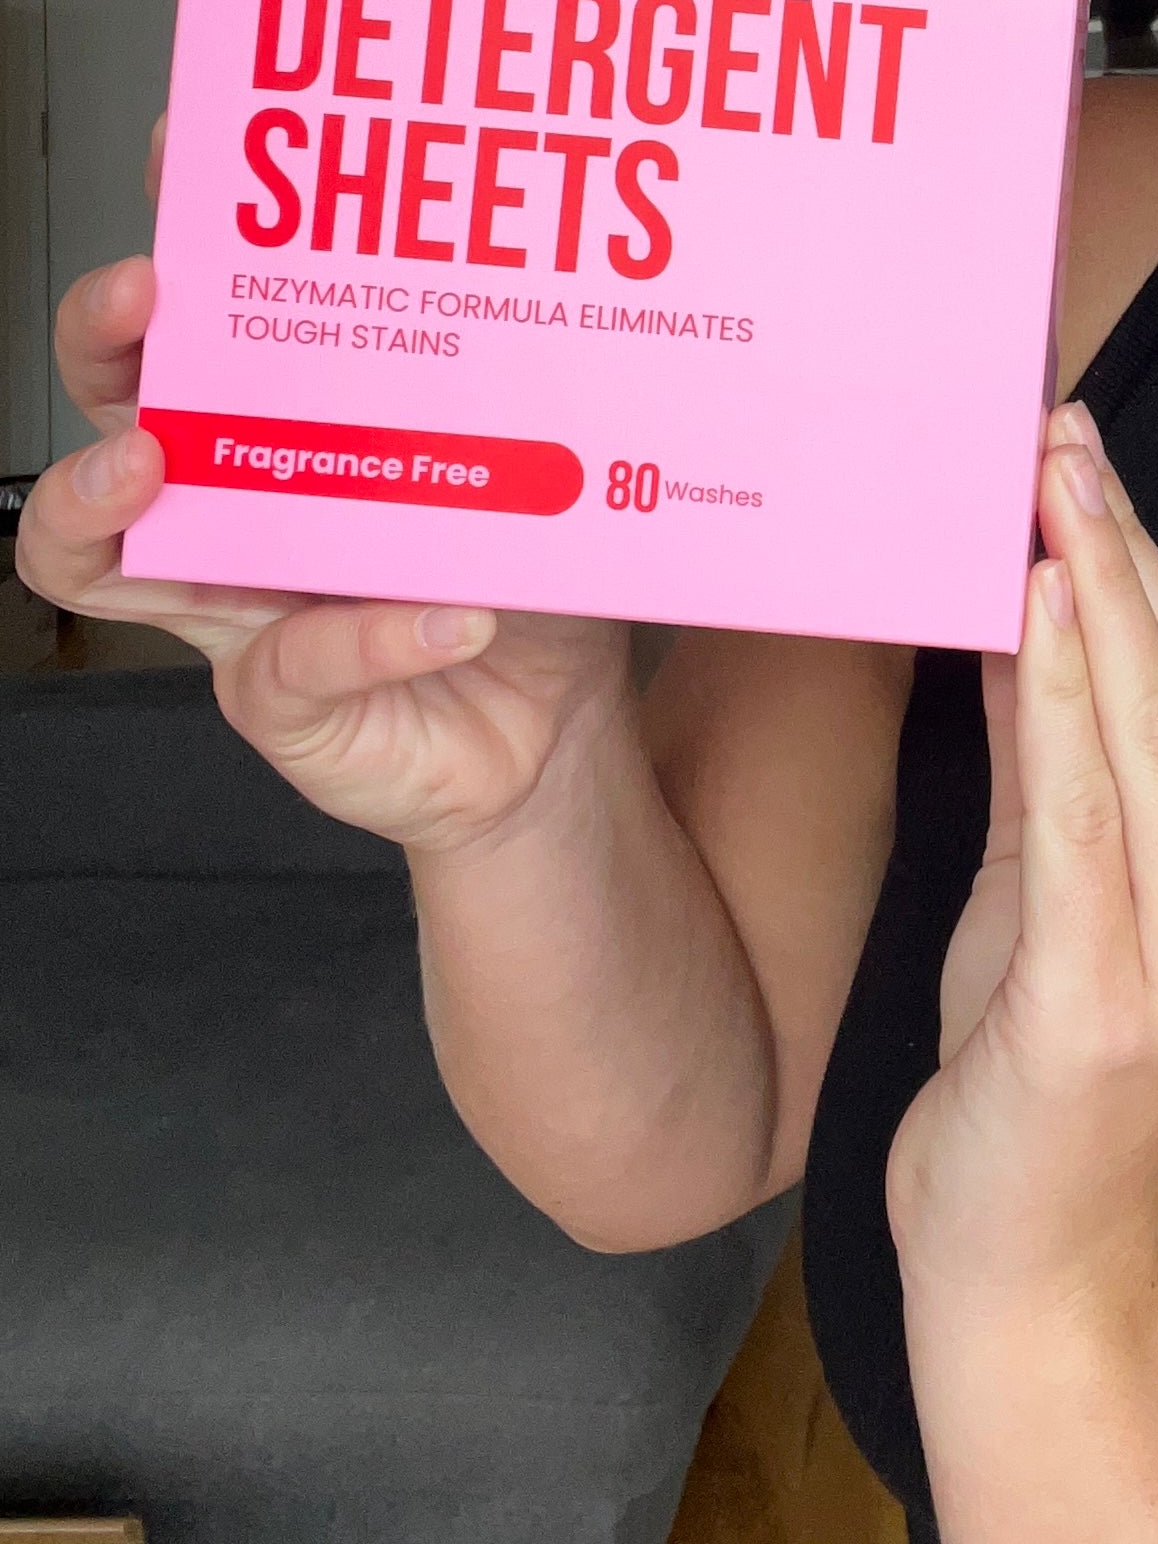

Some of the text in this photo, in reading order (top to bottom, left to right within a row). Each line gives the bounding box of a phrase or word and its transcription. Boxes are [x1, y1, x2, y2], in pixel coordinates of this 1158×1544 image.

[236, 107, 680, 281] SHEETS
[228, 314, 461, 357] TOUGH STAINS
[231, 274, 755, 343] ENZYMATIC FORMULA ELIMINATES
[213, 436, 490, 489] Fragrance Free
[605, 459, 763, 514] 80 Washes
